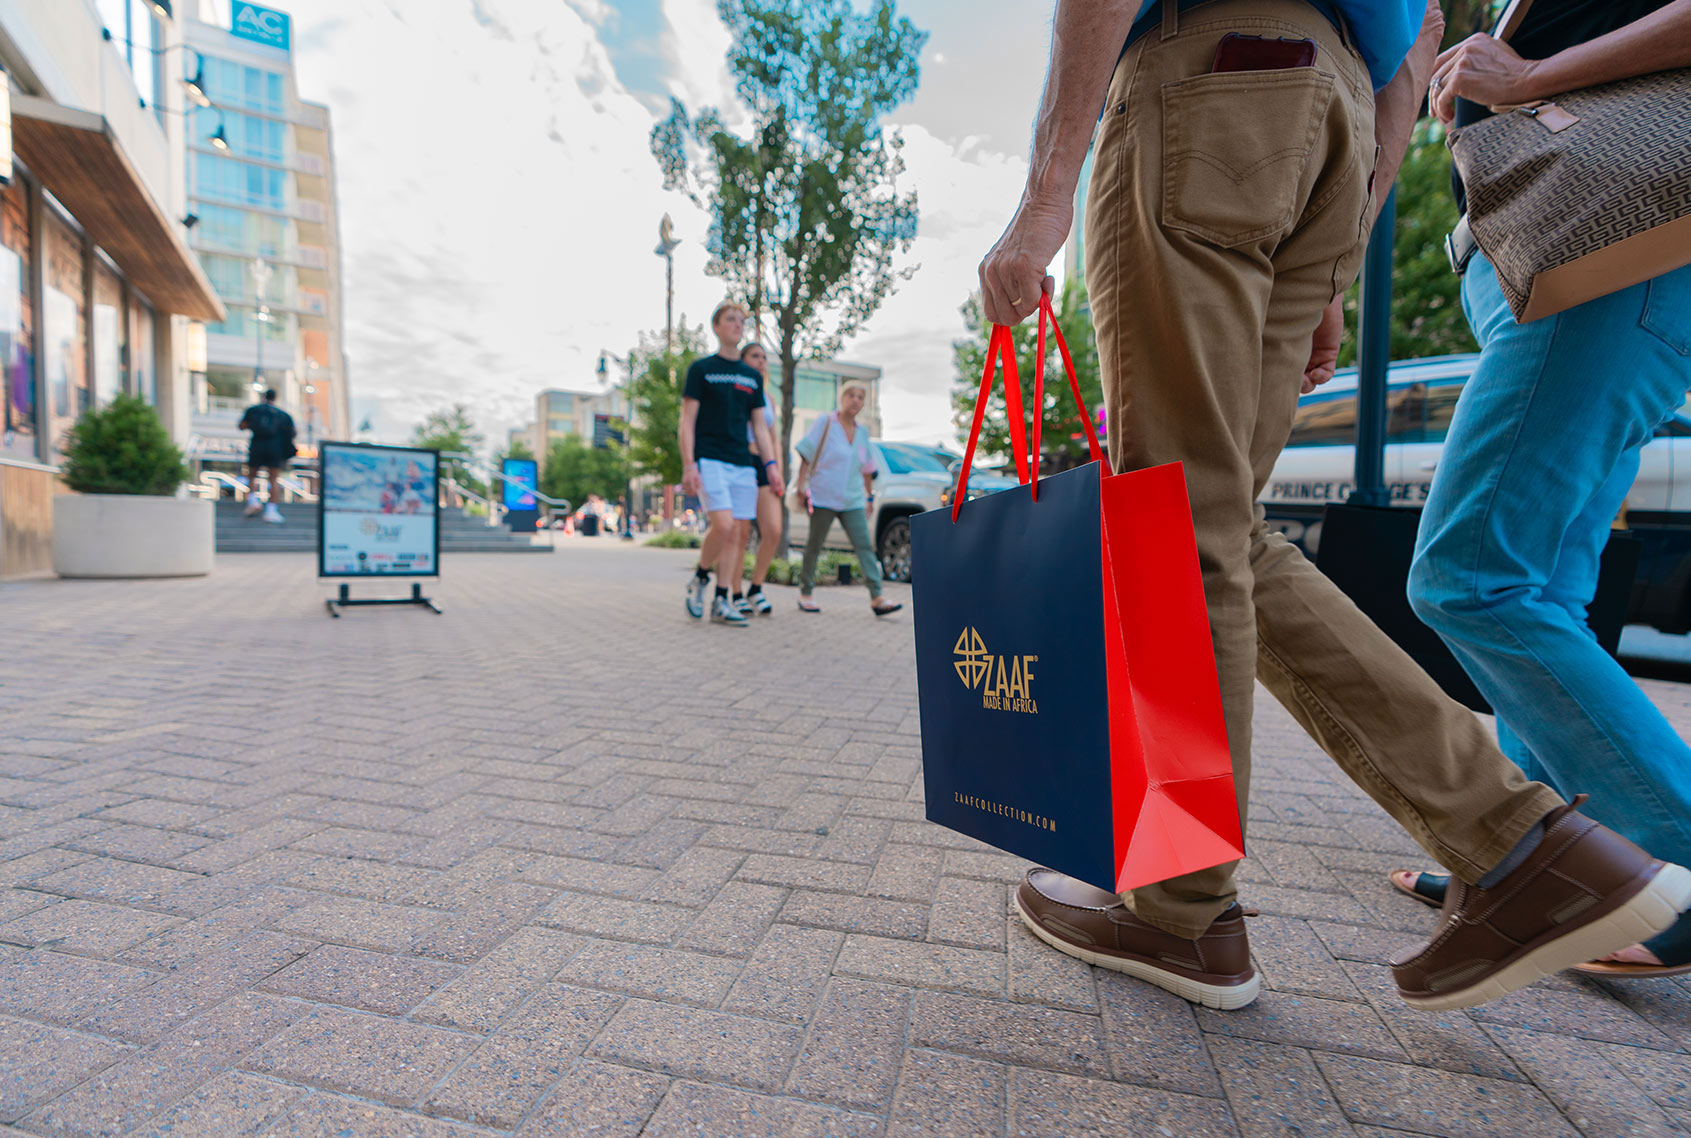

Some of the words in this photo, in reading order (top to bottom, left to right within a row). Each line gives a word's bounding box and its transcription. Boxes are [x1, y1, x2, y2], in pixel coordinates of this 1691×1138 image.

[237, 5, 283, 35] AC
[1271, 482, 1334, 499] PRINCE
[983, 655, 1034, 699] ZAAF
[983, 696, 1001, 710] MADE
[1003, 697, 1011, 711] IN
[1012, 698, 1038, 714] AFRICA
[955, 791, 1056, 832] ZAAFCOLLECTION.COM
